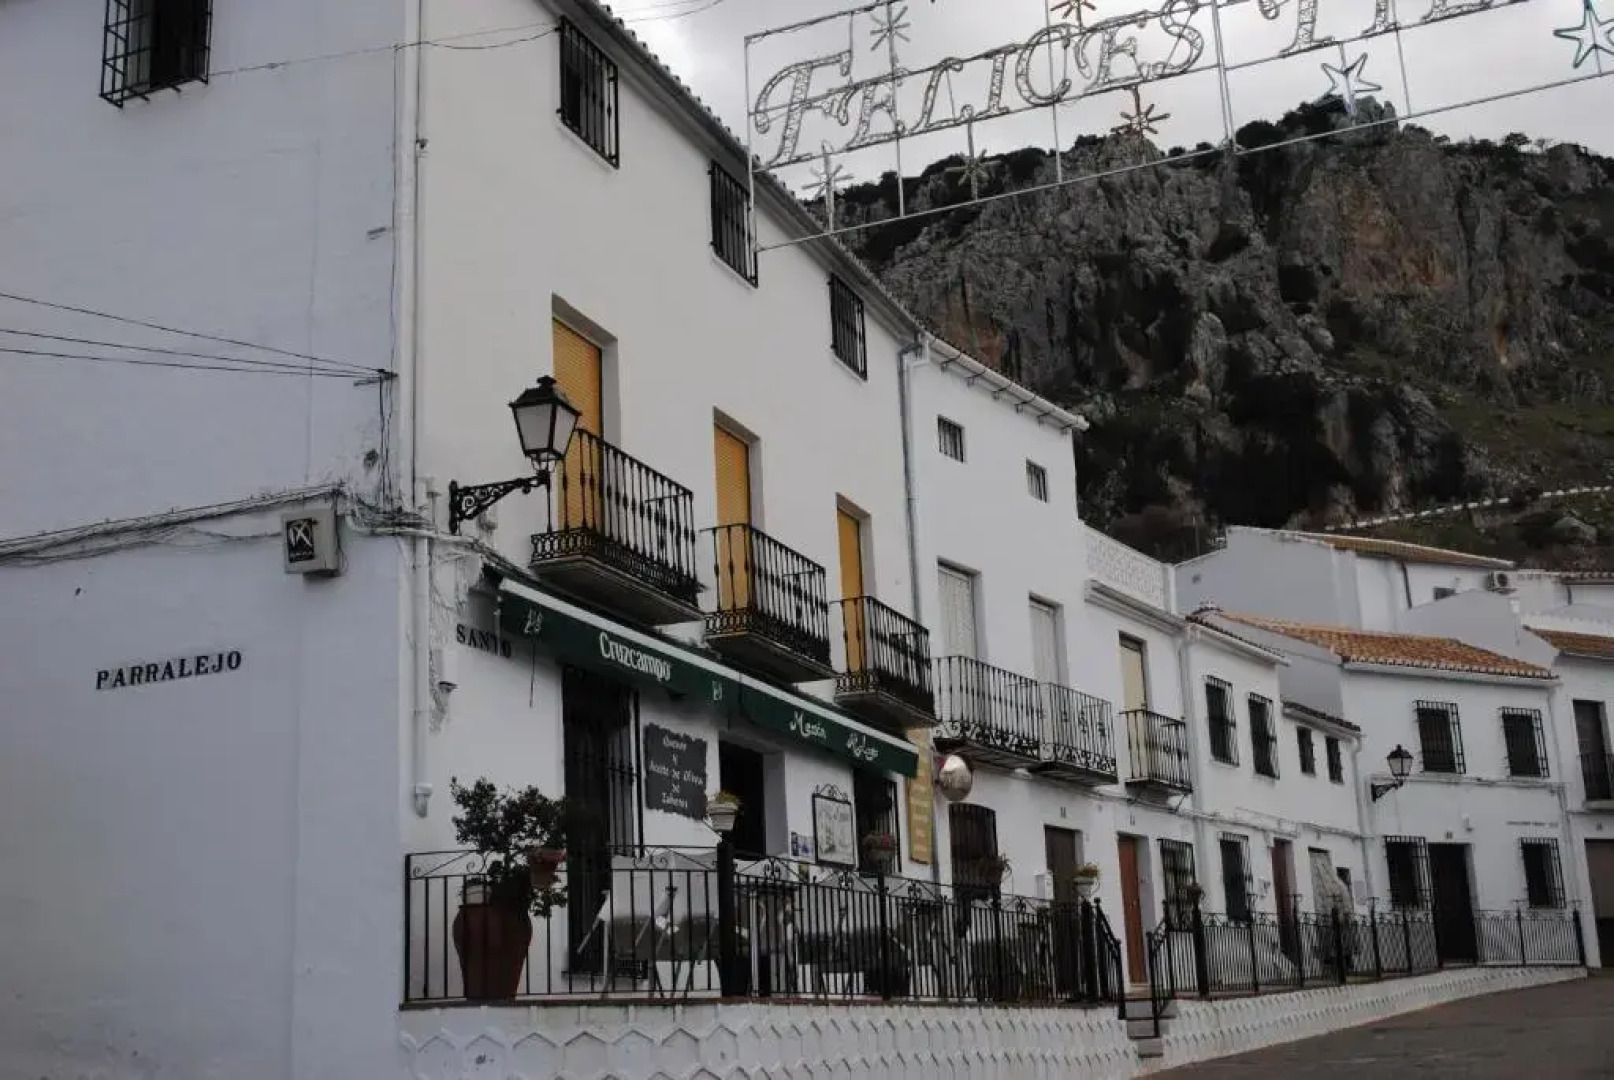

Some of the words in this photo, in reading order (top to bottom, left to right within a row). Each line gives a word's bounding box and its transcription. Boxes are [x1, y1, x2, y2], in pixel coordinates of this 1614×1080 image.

[755, 0, 1205, 165] FELICES
[456, 623, 512, 658] SANTO
[599, 631, 671, 682] Cruzcampo
[95, 650, 243, 690] PARRALEJO
